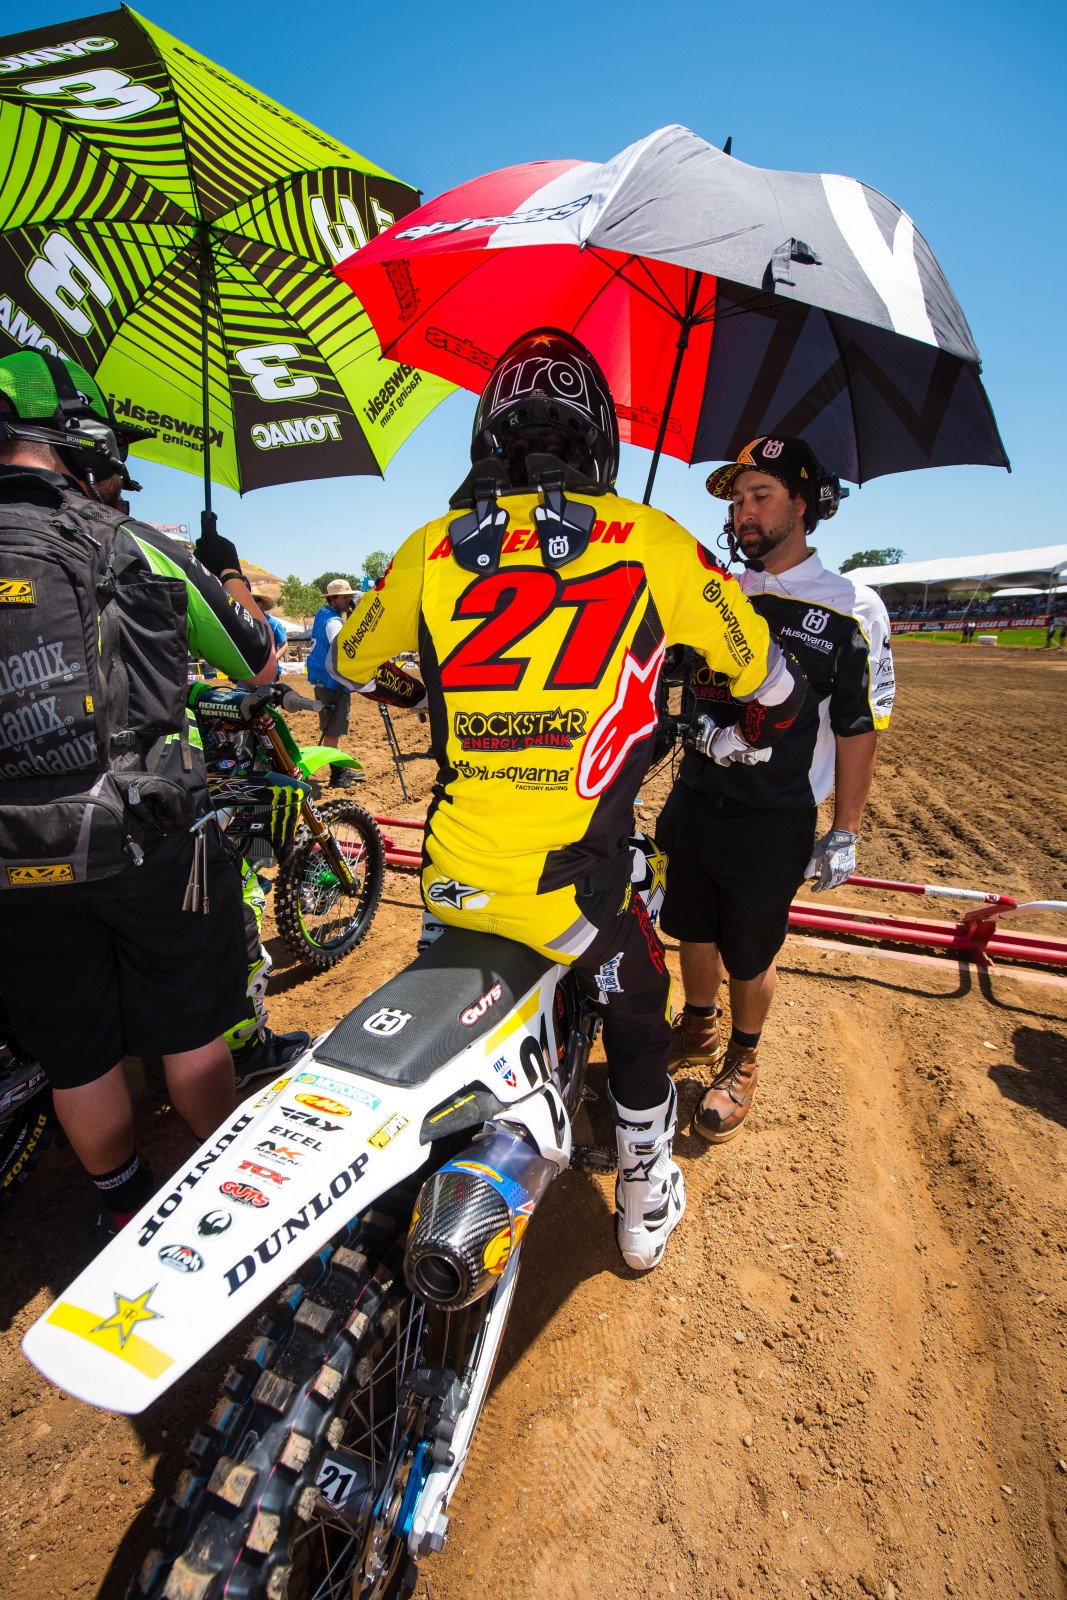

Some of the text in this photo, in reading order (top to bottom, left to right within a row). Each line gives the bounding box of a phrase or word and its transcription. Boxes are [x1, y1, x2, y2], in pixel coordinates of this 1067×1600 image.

[349, 597, 382, 649] Husqvarna
[439, 560, 648, 692] 21
[781, 626, 834, 650] Husqvarna
[199, 702, 239, 711] RENTHAL
[201, 709, 241, 719] RENTHAL
[0, 729, 98, 781] echanix
[464, 733, 571, 749] ENERGY DRINK
[460, 983, 503, 1026] GUTS
[313, 1078, 380, 1110] MOTOREX
[280, 1106, 344, 1131] FLY
[3, 1114, 48, 1188] DUNLOP
[268, 1126, 322, 1152] EXCEL
[253, 1146, 299, 1166] NEKEN
[138, 1114, 255, 1247] DUNLOP
[221, 1181, 270, 1206] GUTS
[223, 1153, 370, 1297] DUNLOP
[318, 1465, 353, 1504] 21
